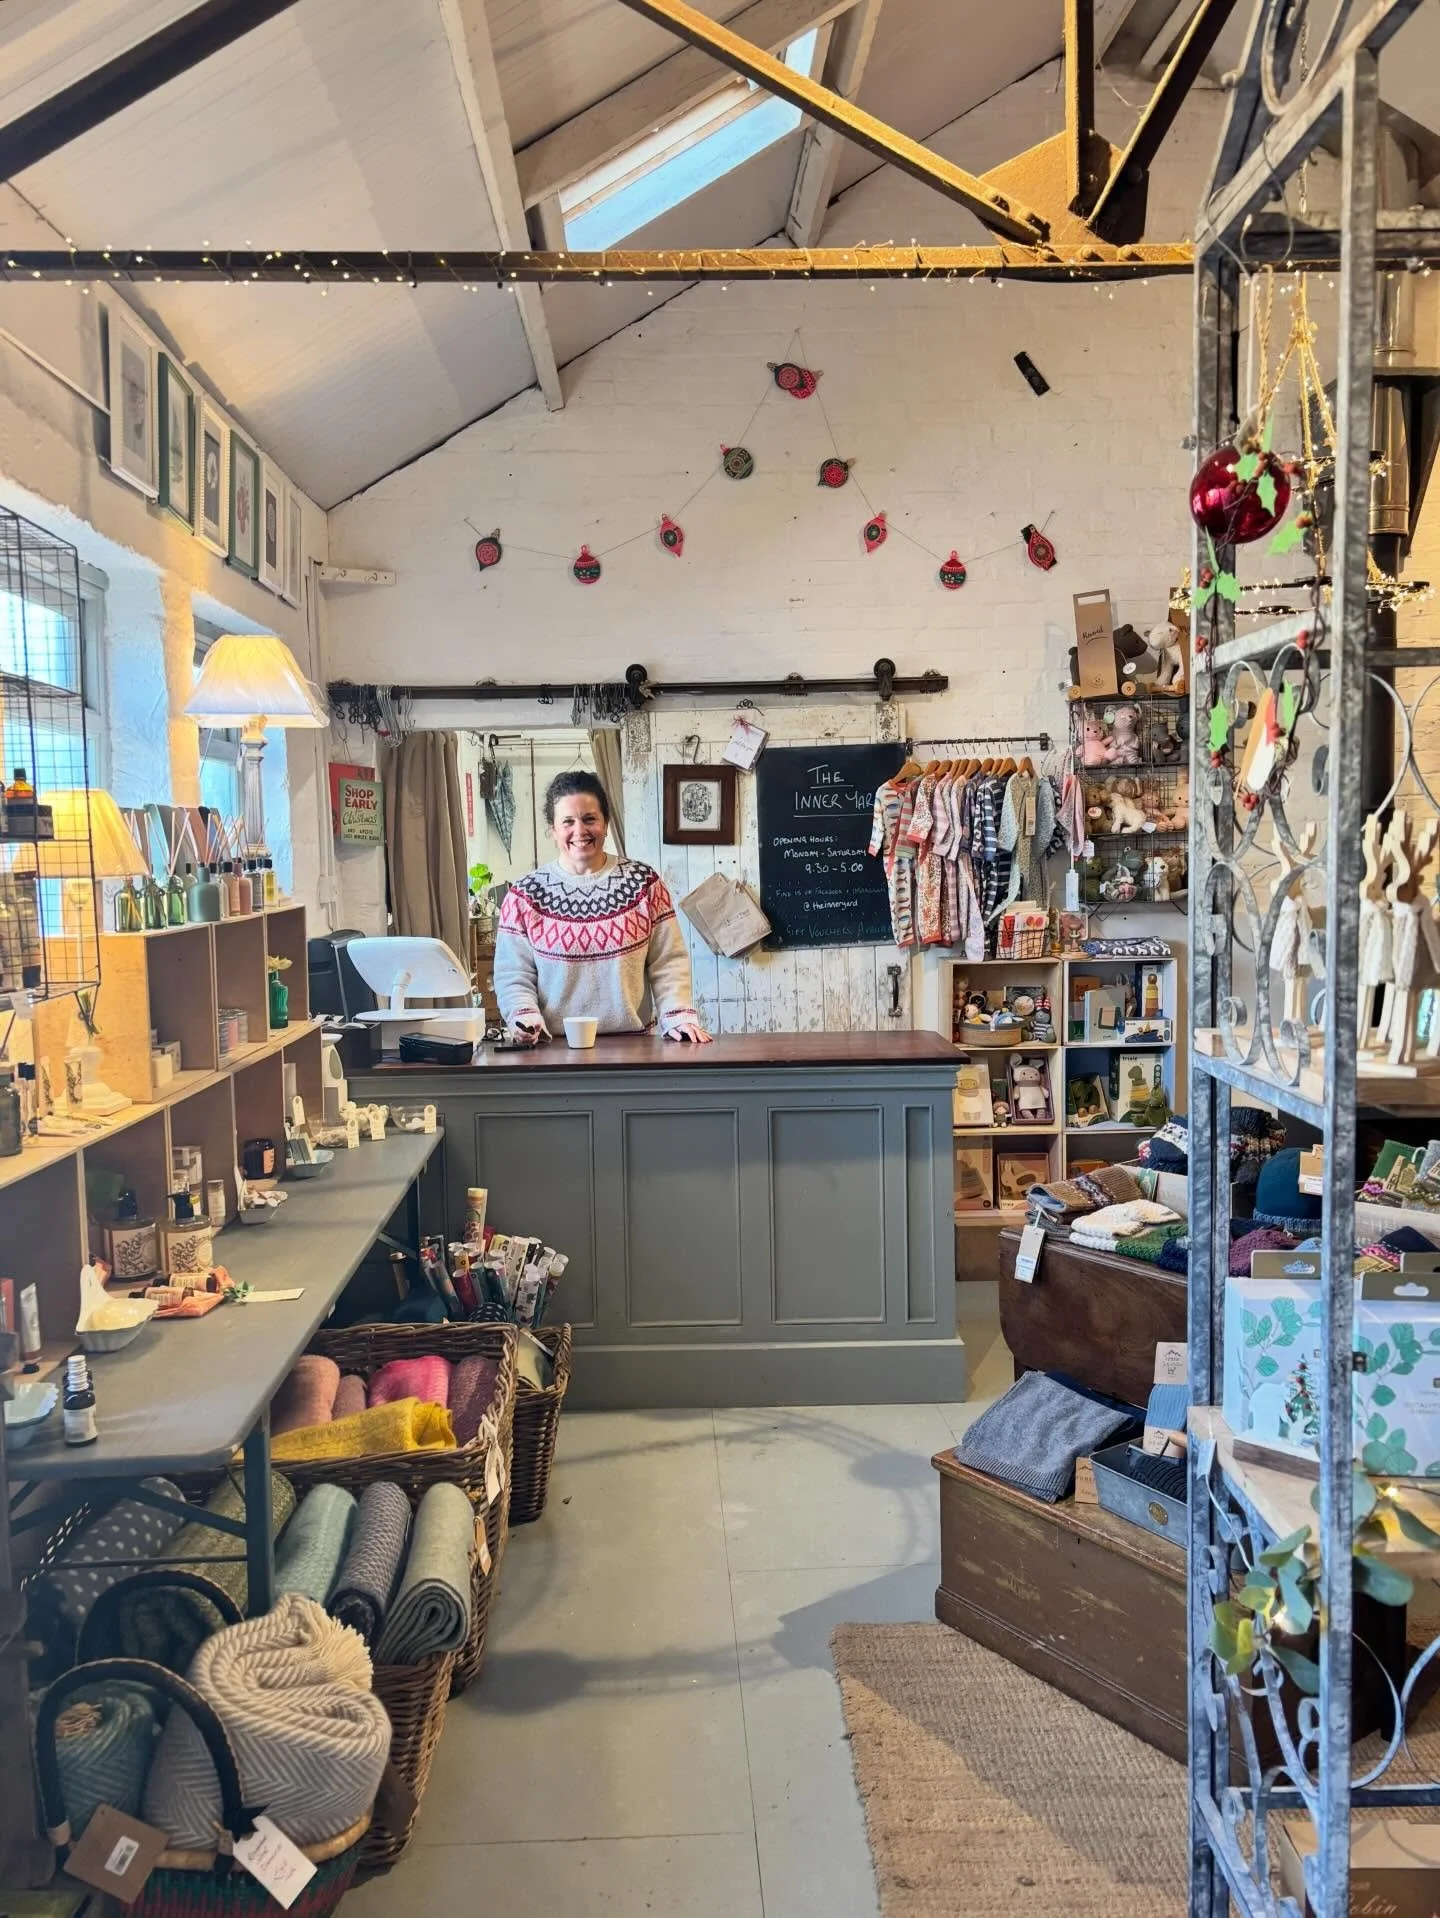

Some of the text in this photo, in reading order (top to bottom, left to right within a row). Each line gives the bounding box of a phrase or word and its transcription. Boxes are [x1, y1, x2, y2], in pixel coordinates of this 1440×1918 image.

[807, 764, 845, 784] THE
[344, 784, 374, 799] SHOP
[344, 798, 378, 810] EARLY
[795, 790, 875, 810] INNER YAR
[773, 836, 808, 847] OPENING
[783, 848, 819, 859] MONDAY
[827, 847, 867, 858] SATURDAY
[805, 863, 829, 874] 9.30
[840, 862, 864, 873] 5.00
[1350, 1895, 1399, 1915] obin
